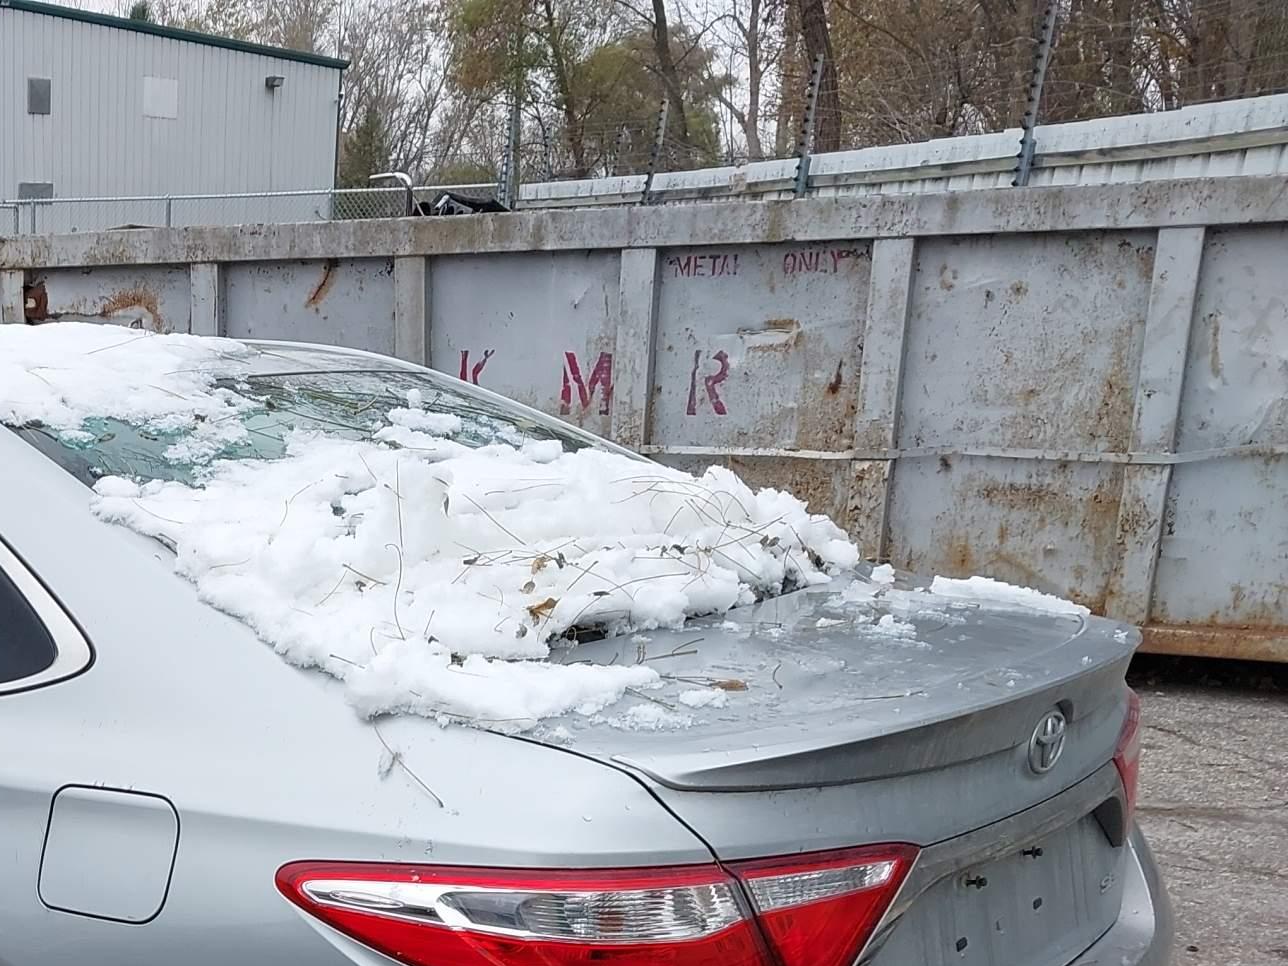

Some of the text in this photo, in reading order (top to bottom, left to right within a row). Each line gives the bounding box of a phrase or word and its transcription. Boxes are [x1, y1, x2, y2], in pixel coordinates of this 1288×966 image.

[783, 248, 840, 275] ONLY
[560, 351, 613, 416] M
[686, 349, 728, 416] R
